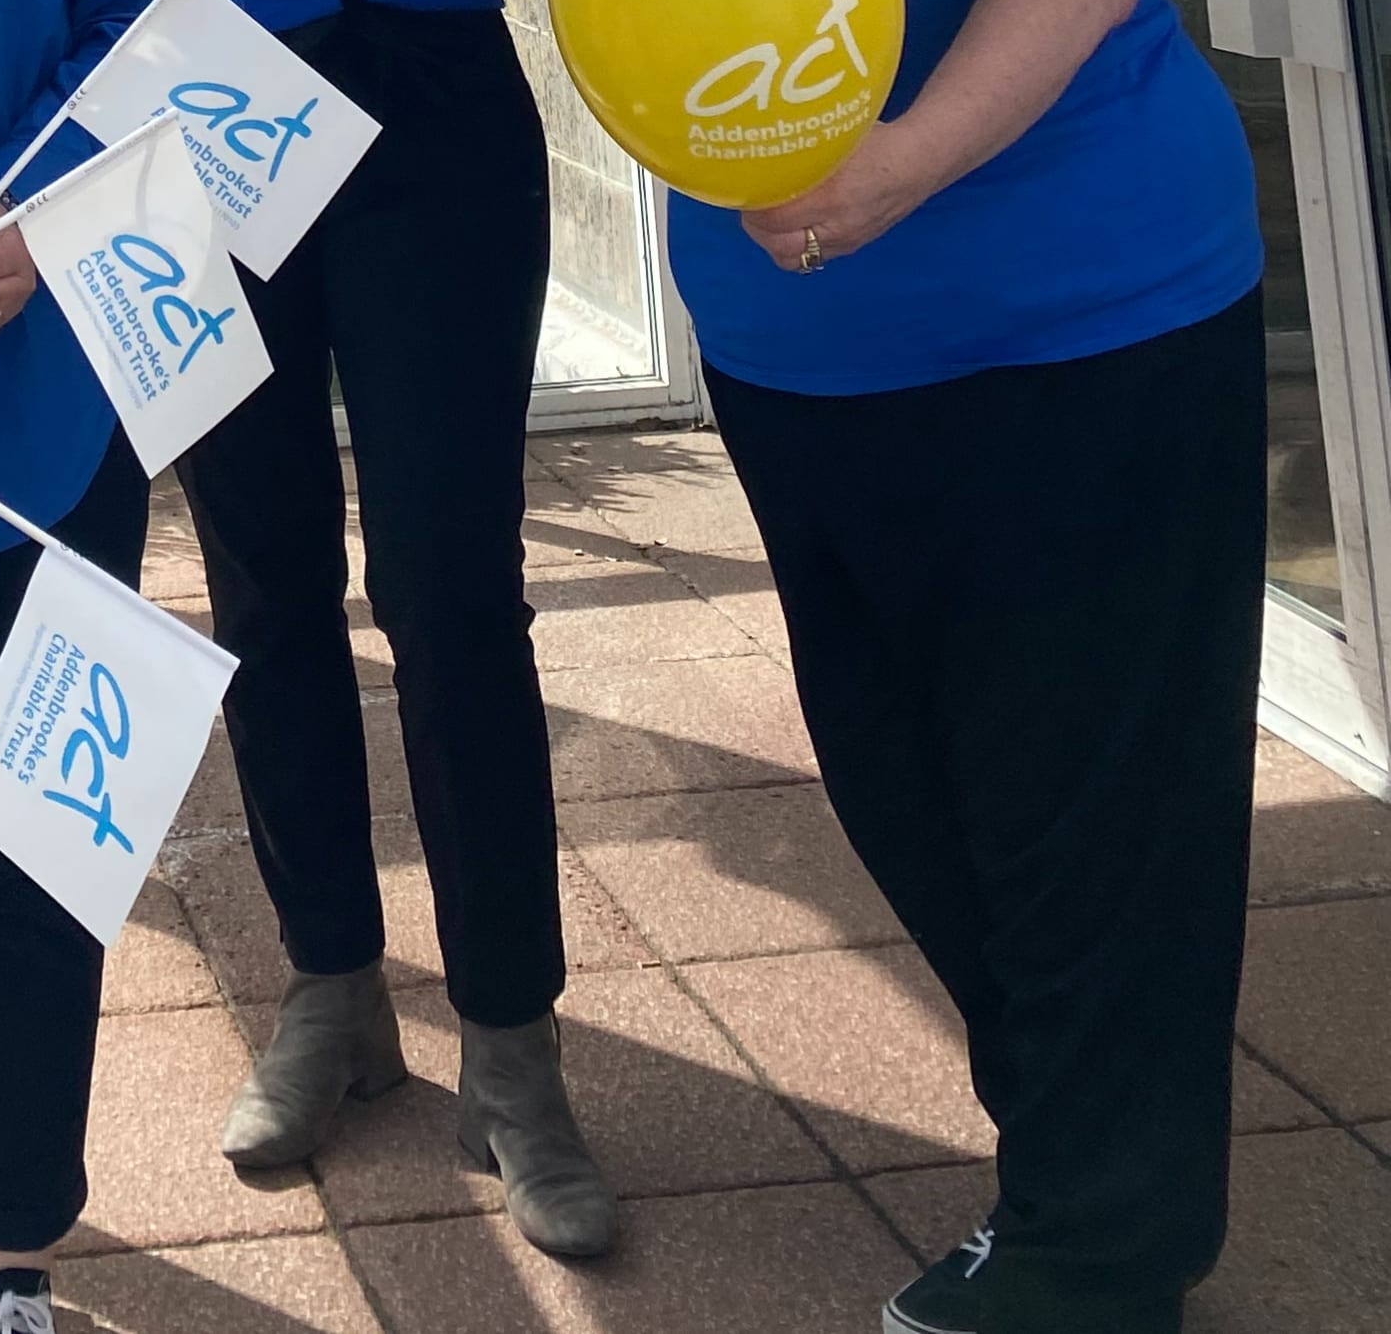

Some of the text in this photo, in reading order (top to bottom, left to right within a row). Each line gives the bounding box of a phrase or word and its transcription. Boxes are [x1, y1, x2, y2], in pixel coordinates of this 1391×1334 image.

[168, 81, 319, 183] act
[688, 88, 872, 143] Addenbrooke's
[689, 106, 871, 161] Charitable Trust
[214, 183, 253, 220] Trust
[76, 258, 133, 353] Charitable
[129, 350, 157, 402] Trust
[90, 249, 171, 391] Addenbrooke's
[111, 234, 236, 374] act
[18, 643, 87, 785] Addenbrooke's
[22, 633, 68, 720] Charitable
[0, 721, 33, 771] Trust
[42, 662, 135, 855] act
